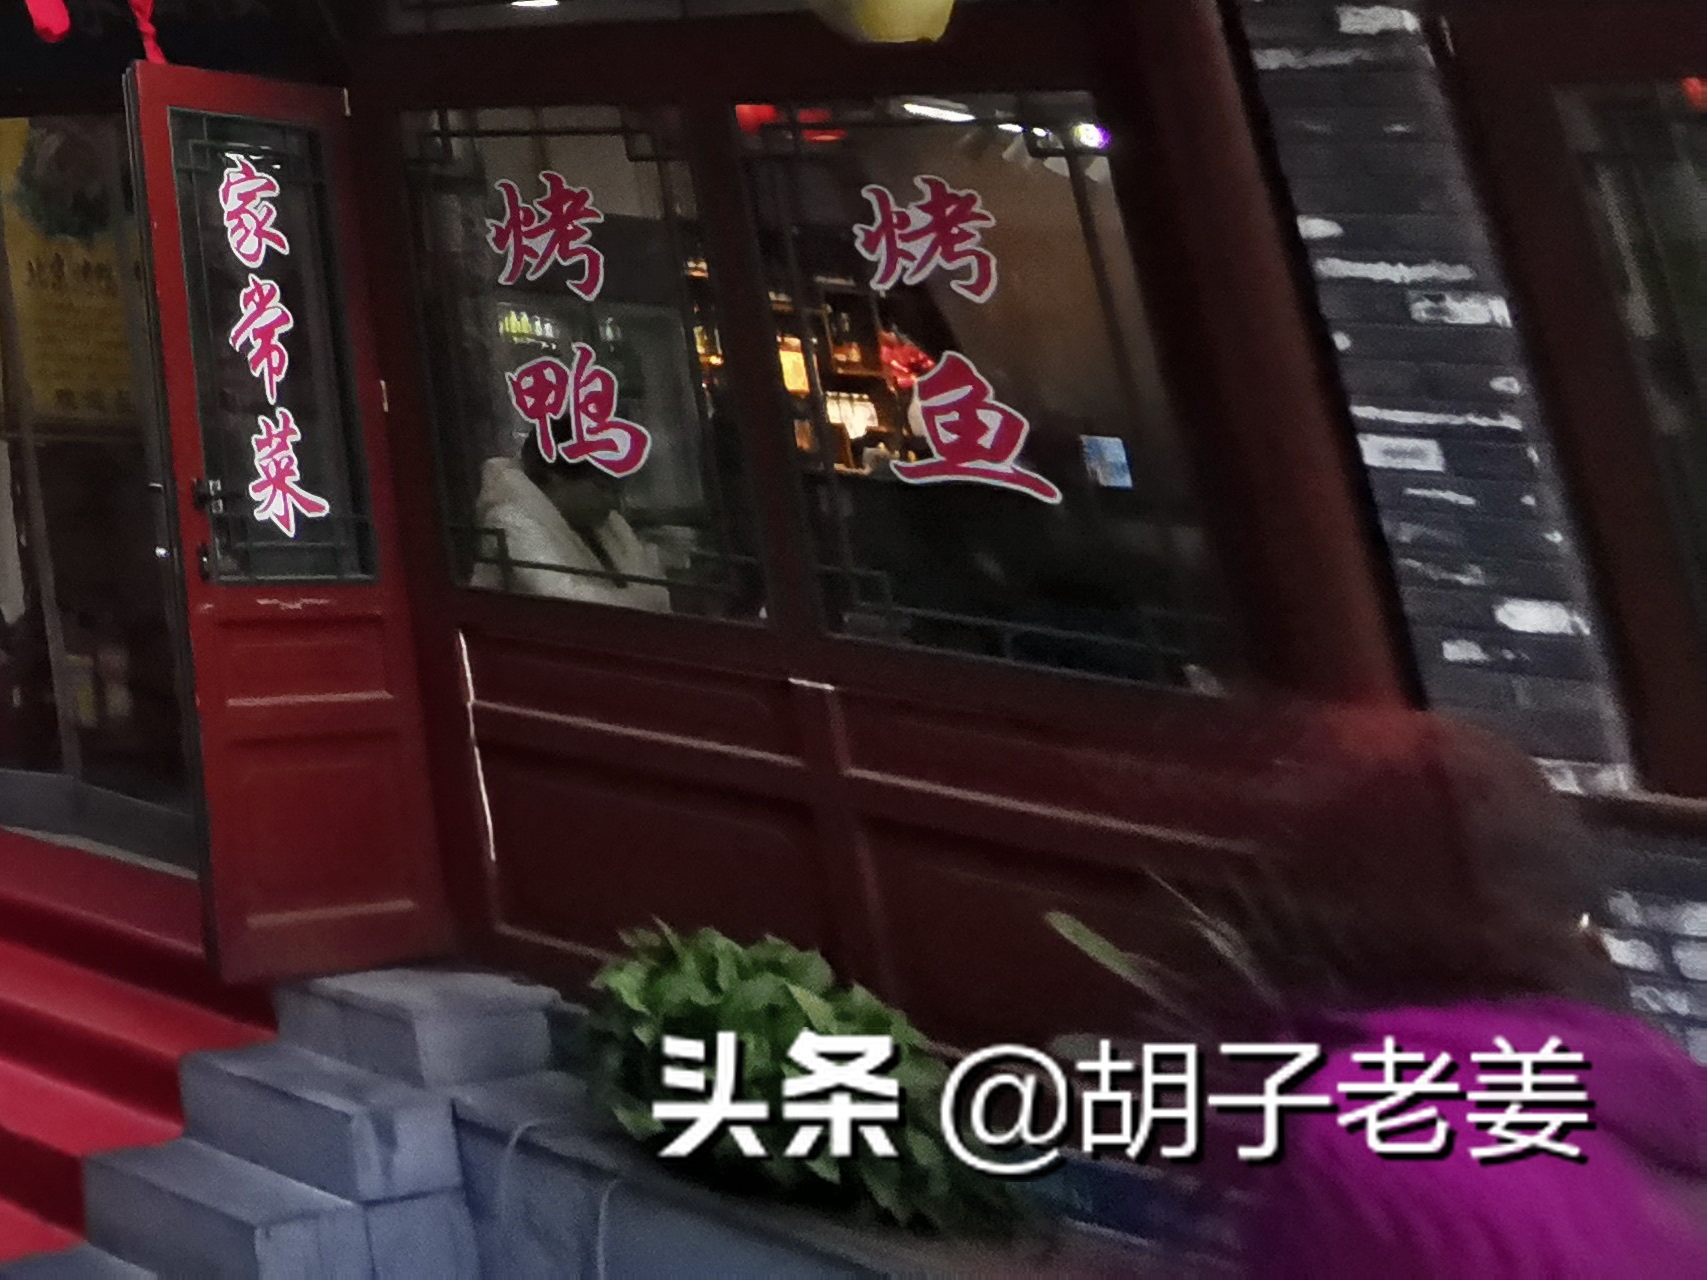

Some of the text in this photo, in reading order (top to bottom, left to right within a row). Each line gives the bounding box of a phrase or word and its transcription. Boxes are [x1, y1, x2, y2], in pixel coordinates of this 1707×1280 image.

[216, 153, 331, 537] 家常菜
[490, 171, 652, 478] 烤鸭
[854, 174, 1063, 504] 烤鱼
